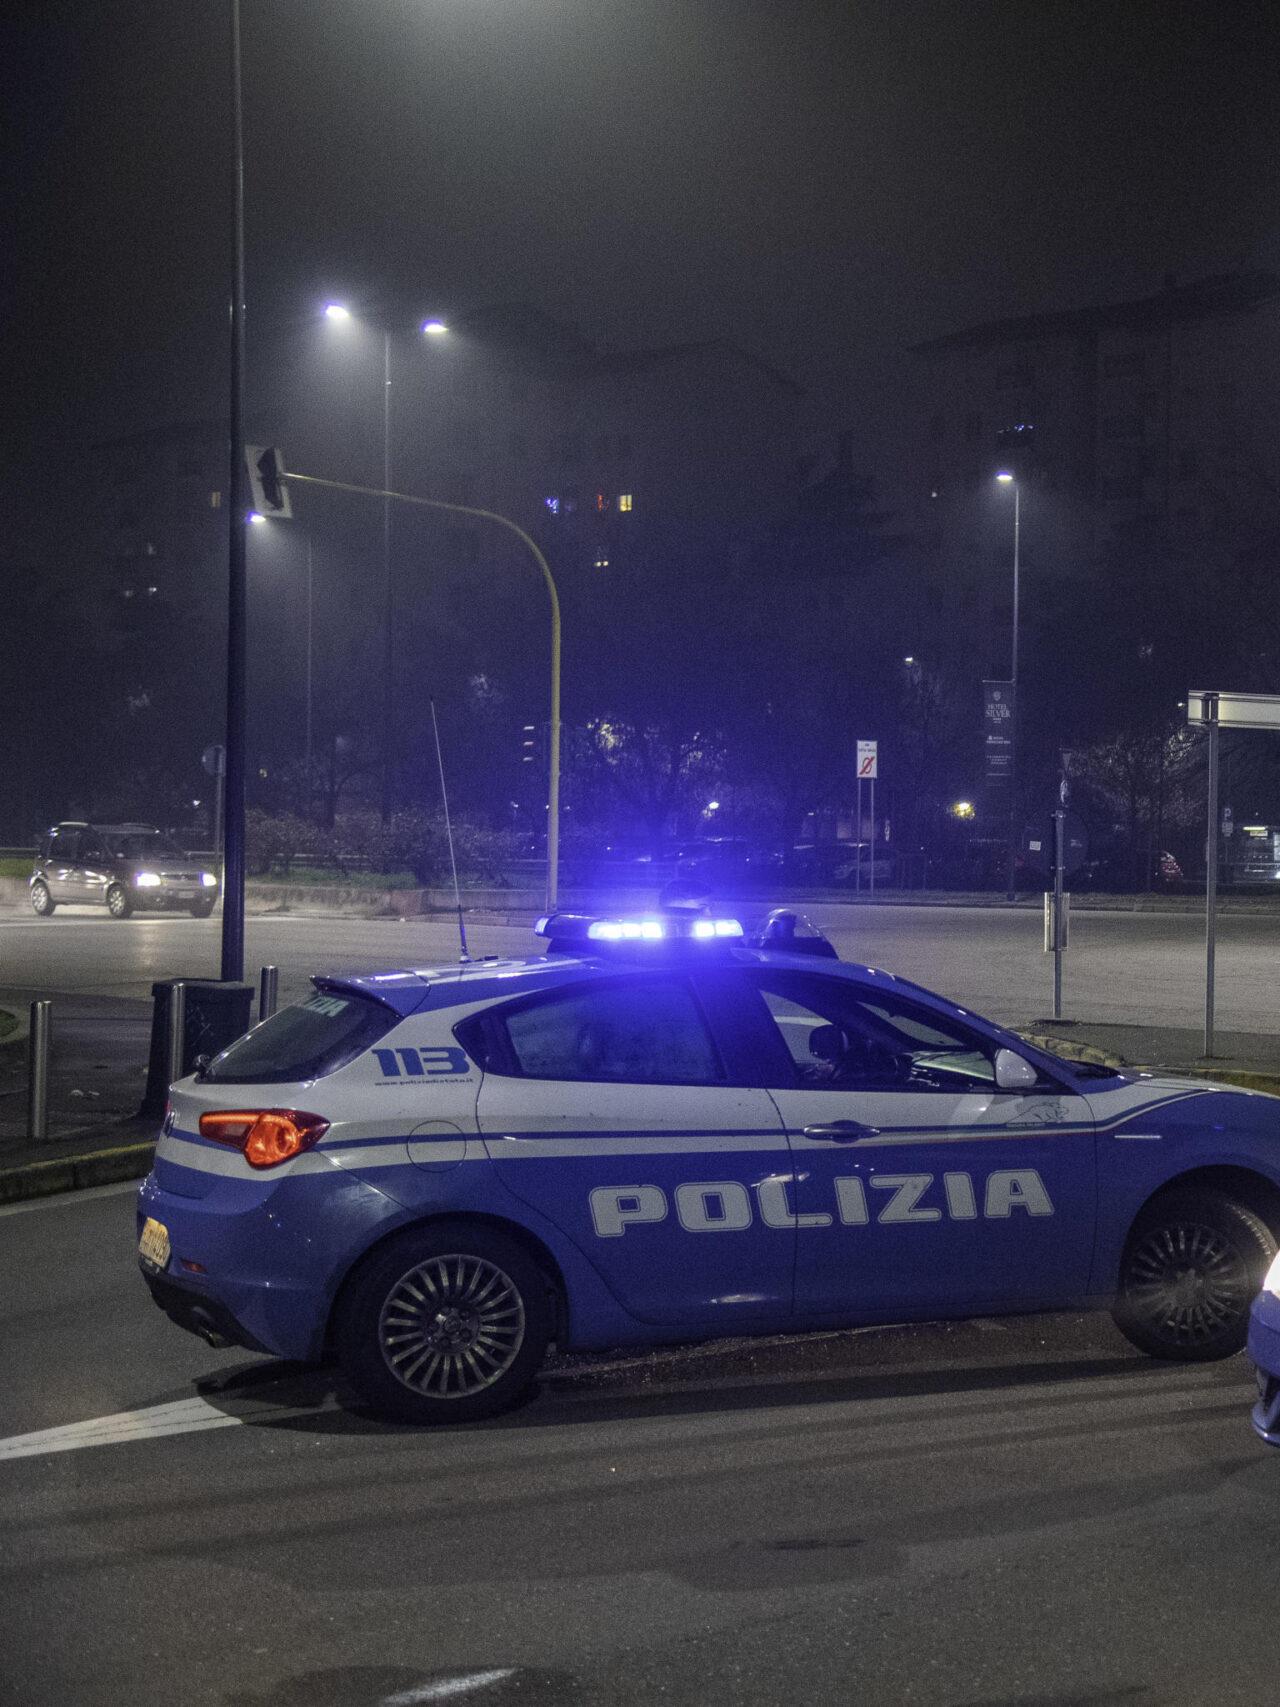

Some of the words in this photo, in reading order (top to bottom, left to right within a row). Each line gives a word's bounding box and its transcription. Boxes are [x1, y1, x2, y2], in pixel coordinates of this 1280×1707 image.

[984, 709, 1011, 718] SILVER
[371, 1046, 470, 1077] 113
[589, 1168, 1056, 1238] POLIZIA
